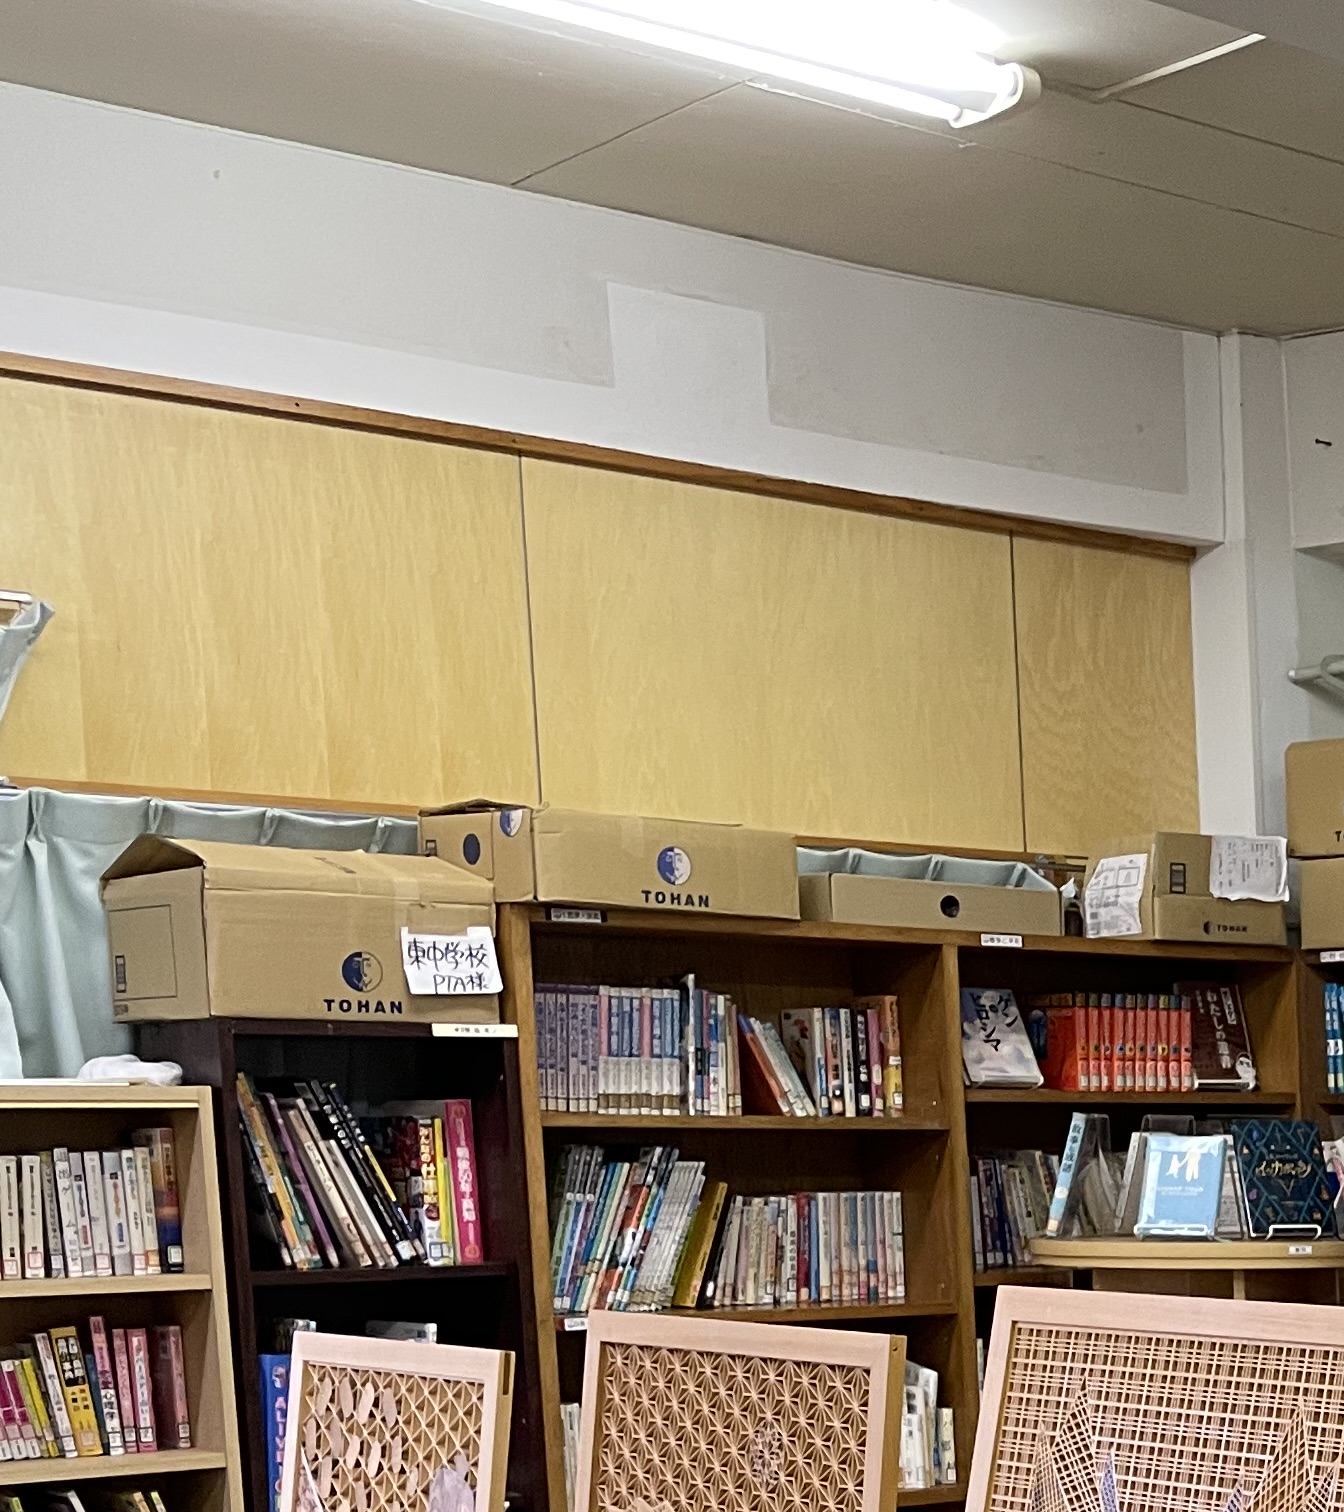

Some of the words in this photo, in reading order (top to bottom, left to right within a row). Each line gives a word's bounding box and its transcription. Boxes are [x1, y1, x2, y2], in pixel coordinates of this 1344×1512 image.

[641, 890, 710, 909] TOHAN
[408, 938, 490, 972] 東中学校
[433, 972, 490, 995] PTA様
[323, 998, 404, 1015] TOHAN
